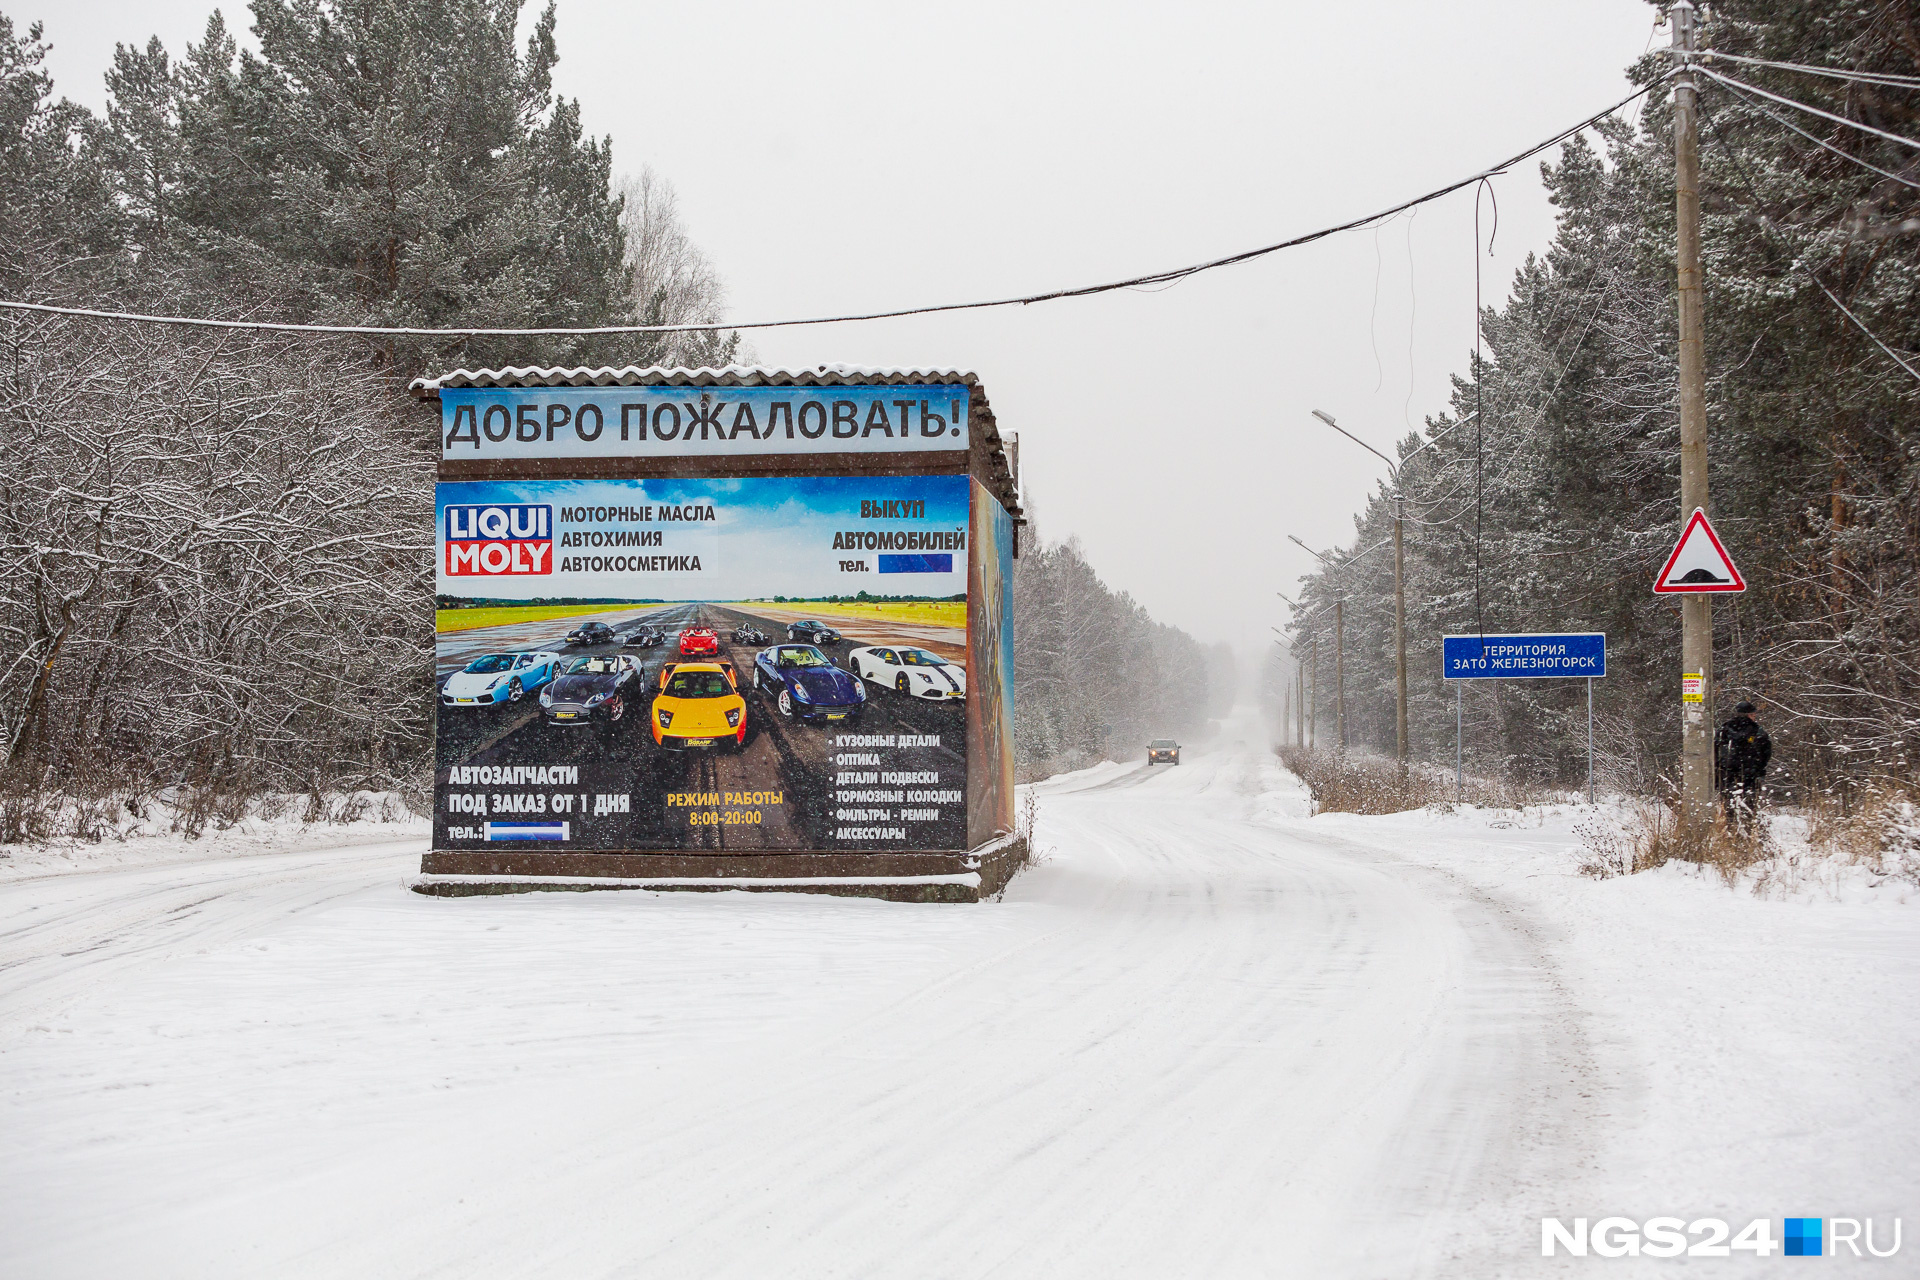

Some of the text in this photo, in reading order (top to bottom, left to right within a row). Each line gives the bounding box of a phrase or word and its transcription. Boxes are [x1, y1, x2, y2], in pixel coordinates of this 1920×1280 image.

[445, 399, 960, 449] ДОБРО ПОЖАЛОВАТЬ!
[560, 505, 716, 522] МОТОРНЫЕ МАСЛА
[860, 499, 925, 518] ВЫКУП
[450, 507, 548, 539] LIQUI
[560, 530, 663, 547] АВТОХИМИЯ
[832, 527, 966, 551] АВТОМОБИЛЕЙ
[450, 542, 551, 573] MOLY
[560, 555, 702, 572] АВТОКОСМЕТИКА
[838, 559, 870, 573] тел.
[1483, 644, 1566, 656] ТЕРРИТОРИЯ
[1453, 656, 1596, 670] ЗАТО ЖЕЛЕЗНОГОРСК
[836, 734, 941, 749] КУЗОВНЫЕ ДЕТАЛИ
[836, 753, 881, 766] ОПТИКА
[448, 765, 578, 785] АВТОЗАПЧАСТИ
[835, 771, 939, 786] ДЕТАЛИ ПОДВЕСКИ
[449, 793, 630, 817] ПОД ЗАКАЗ ОТ 1 ДНЯ
[667, 791, 783, 807] РЕЖИМ РАБОТЫ
[836, 790, 962, 804] ТОРМОЗНЫЕ КОЛОДКИ
[689, 810, 762, 826] 8:00-20:00
[836, 808, 891, 821] ФИЛЬТРЫ
[900, 808, 939, 821] РЕМНИ
[836, 827, 906, 840] АКСЕССУАРЫ
